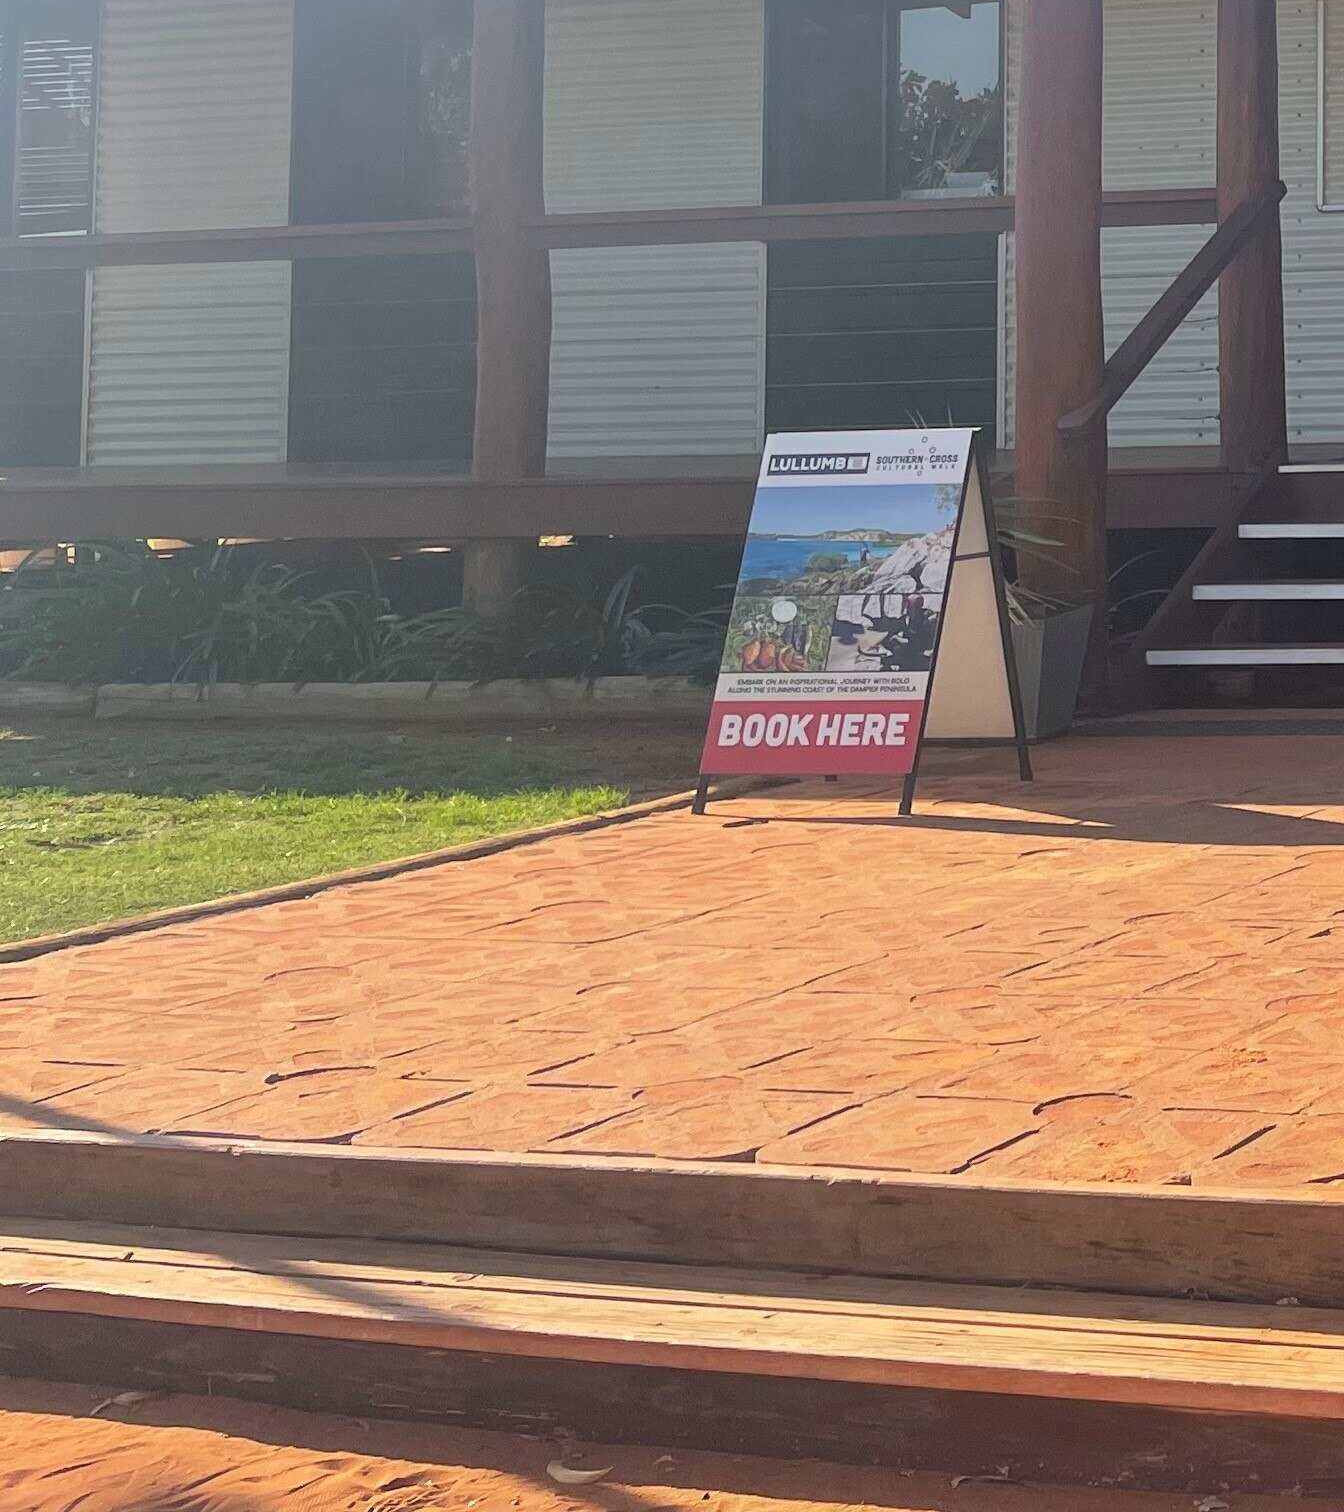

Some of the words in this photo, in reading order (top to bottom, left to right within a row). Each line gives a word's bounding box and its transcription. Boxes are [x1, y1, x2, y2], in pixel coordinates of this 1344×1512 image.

[876, 456, 924, 464] SOUTHERN
[930, 455, 958, 463] CROSS
[718, 713, 814, 747] BOOK
[816, 713, 910, 746] HERE
